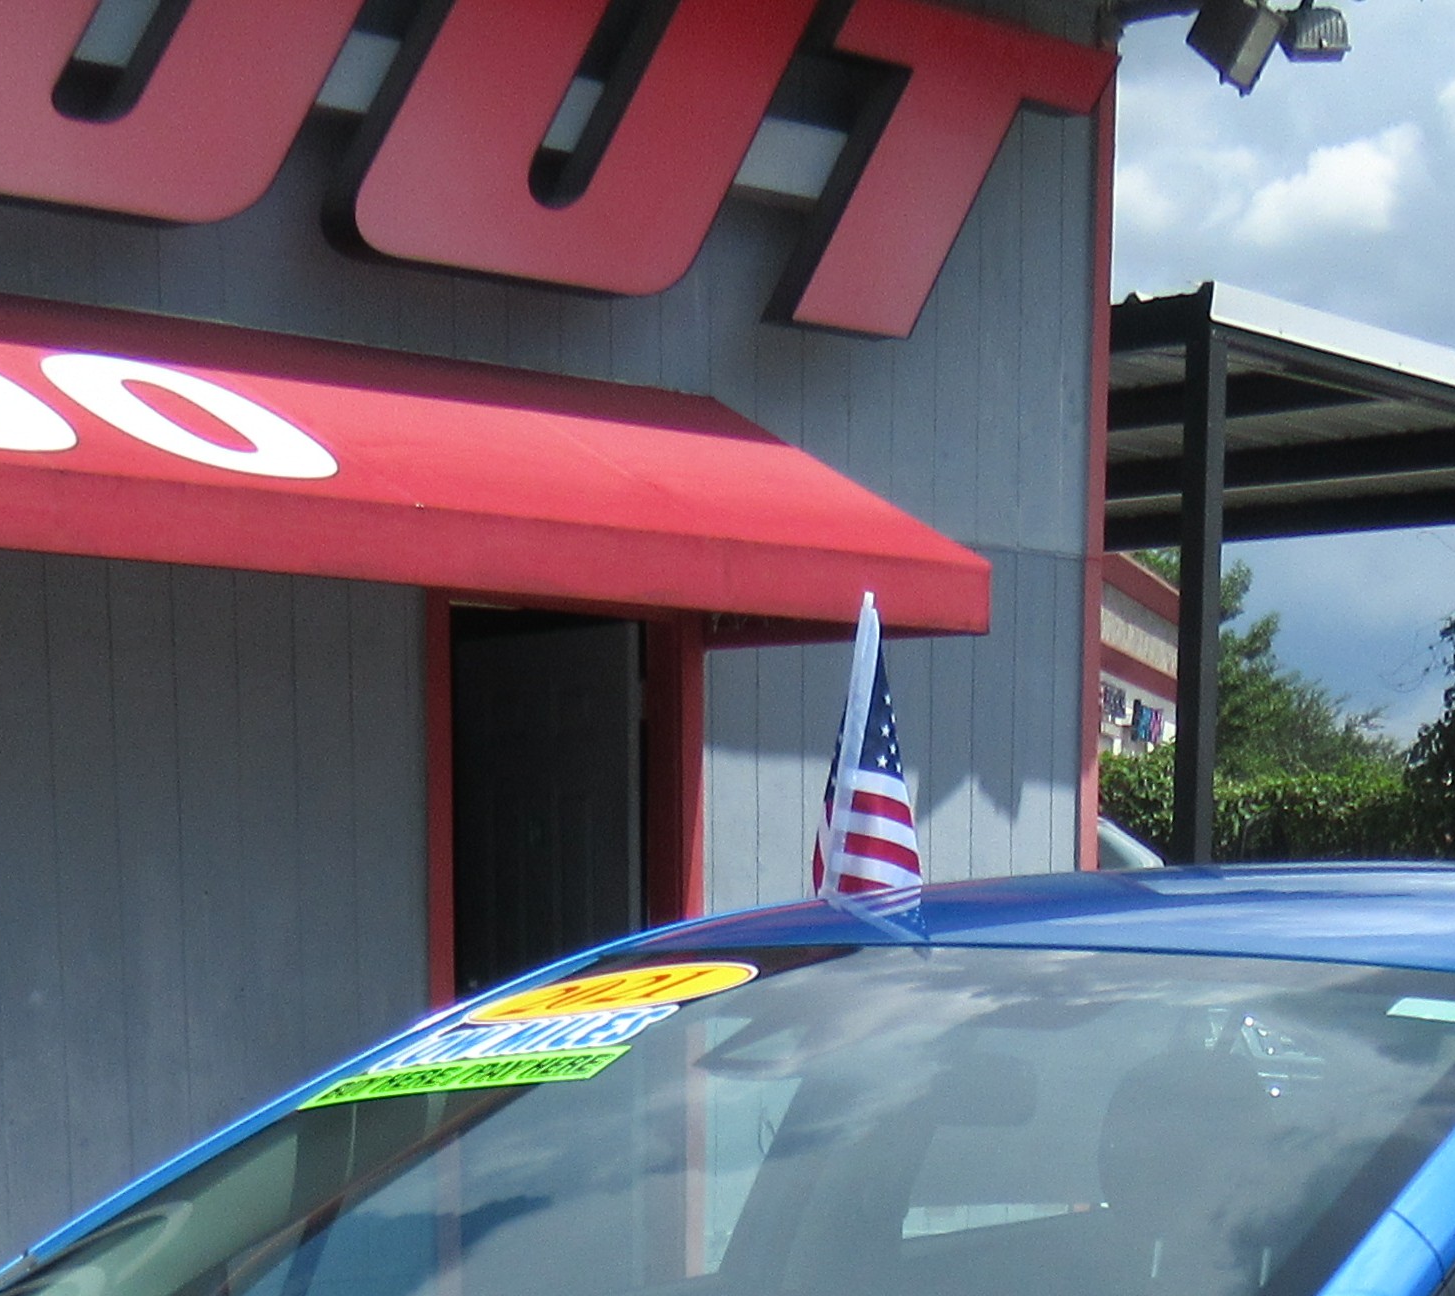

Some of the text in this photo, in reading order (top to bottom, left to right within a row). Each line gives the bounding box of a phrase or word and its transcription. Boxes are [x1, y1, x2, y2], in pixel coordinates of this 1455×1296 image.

[495, 969, 714, 1015] 2021
[374, 1008, 675, 1069] LOW MILES
